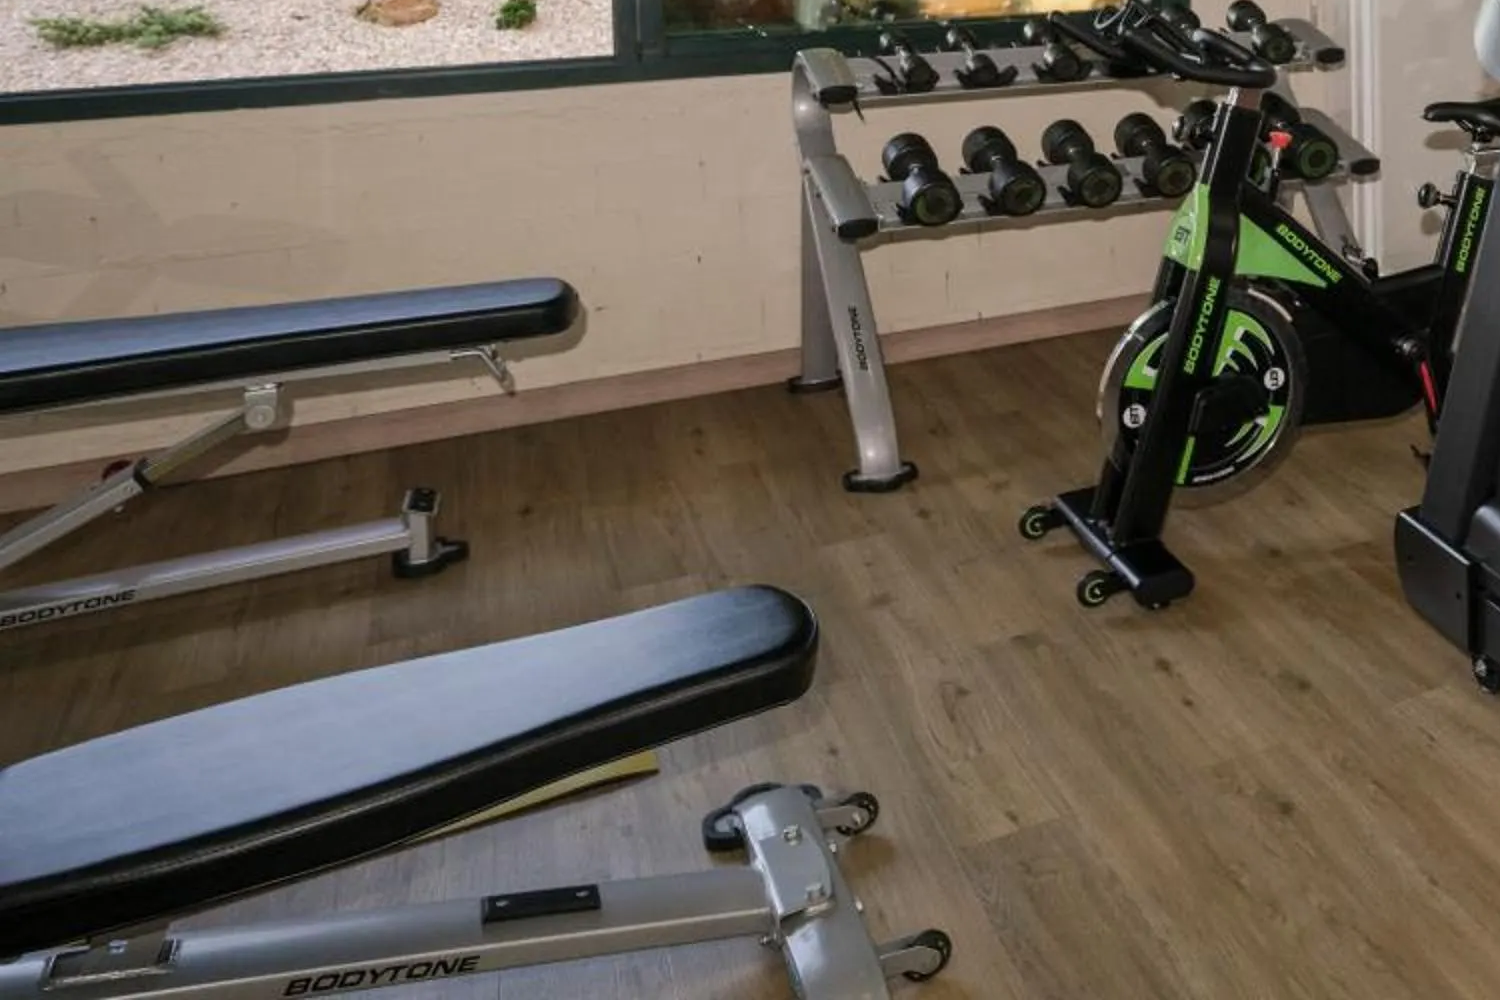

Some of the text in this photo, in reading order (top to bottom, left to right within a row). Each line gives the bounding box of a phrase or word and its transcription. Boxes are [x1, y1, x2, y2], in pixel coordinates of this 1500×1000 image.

[1276, 224, 1342, 284] BODYTONE
[1457, 187, 1485, 273] BODYTONE
[847, 306, 868, 372] BODYTONE
[1183, 277, 1221, 375] BODYTONE
[0, 589, 136, 626] BODYTONE
[284, 955, 481, 997] BODYTONE
